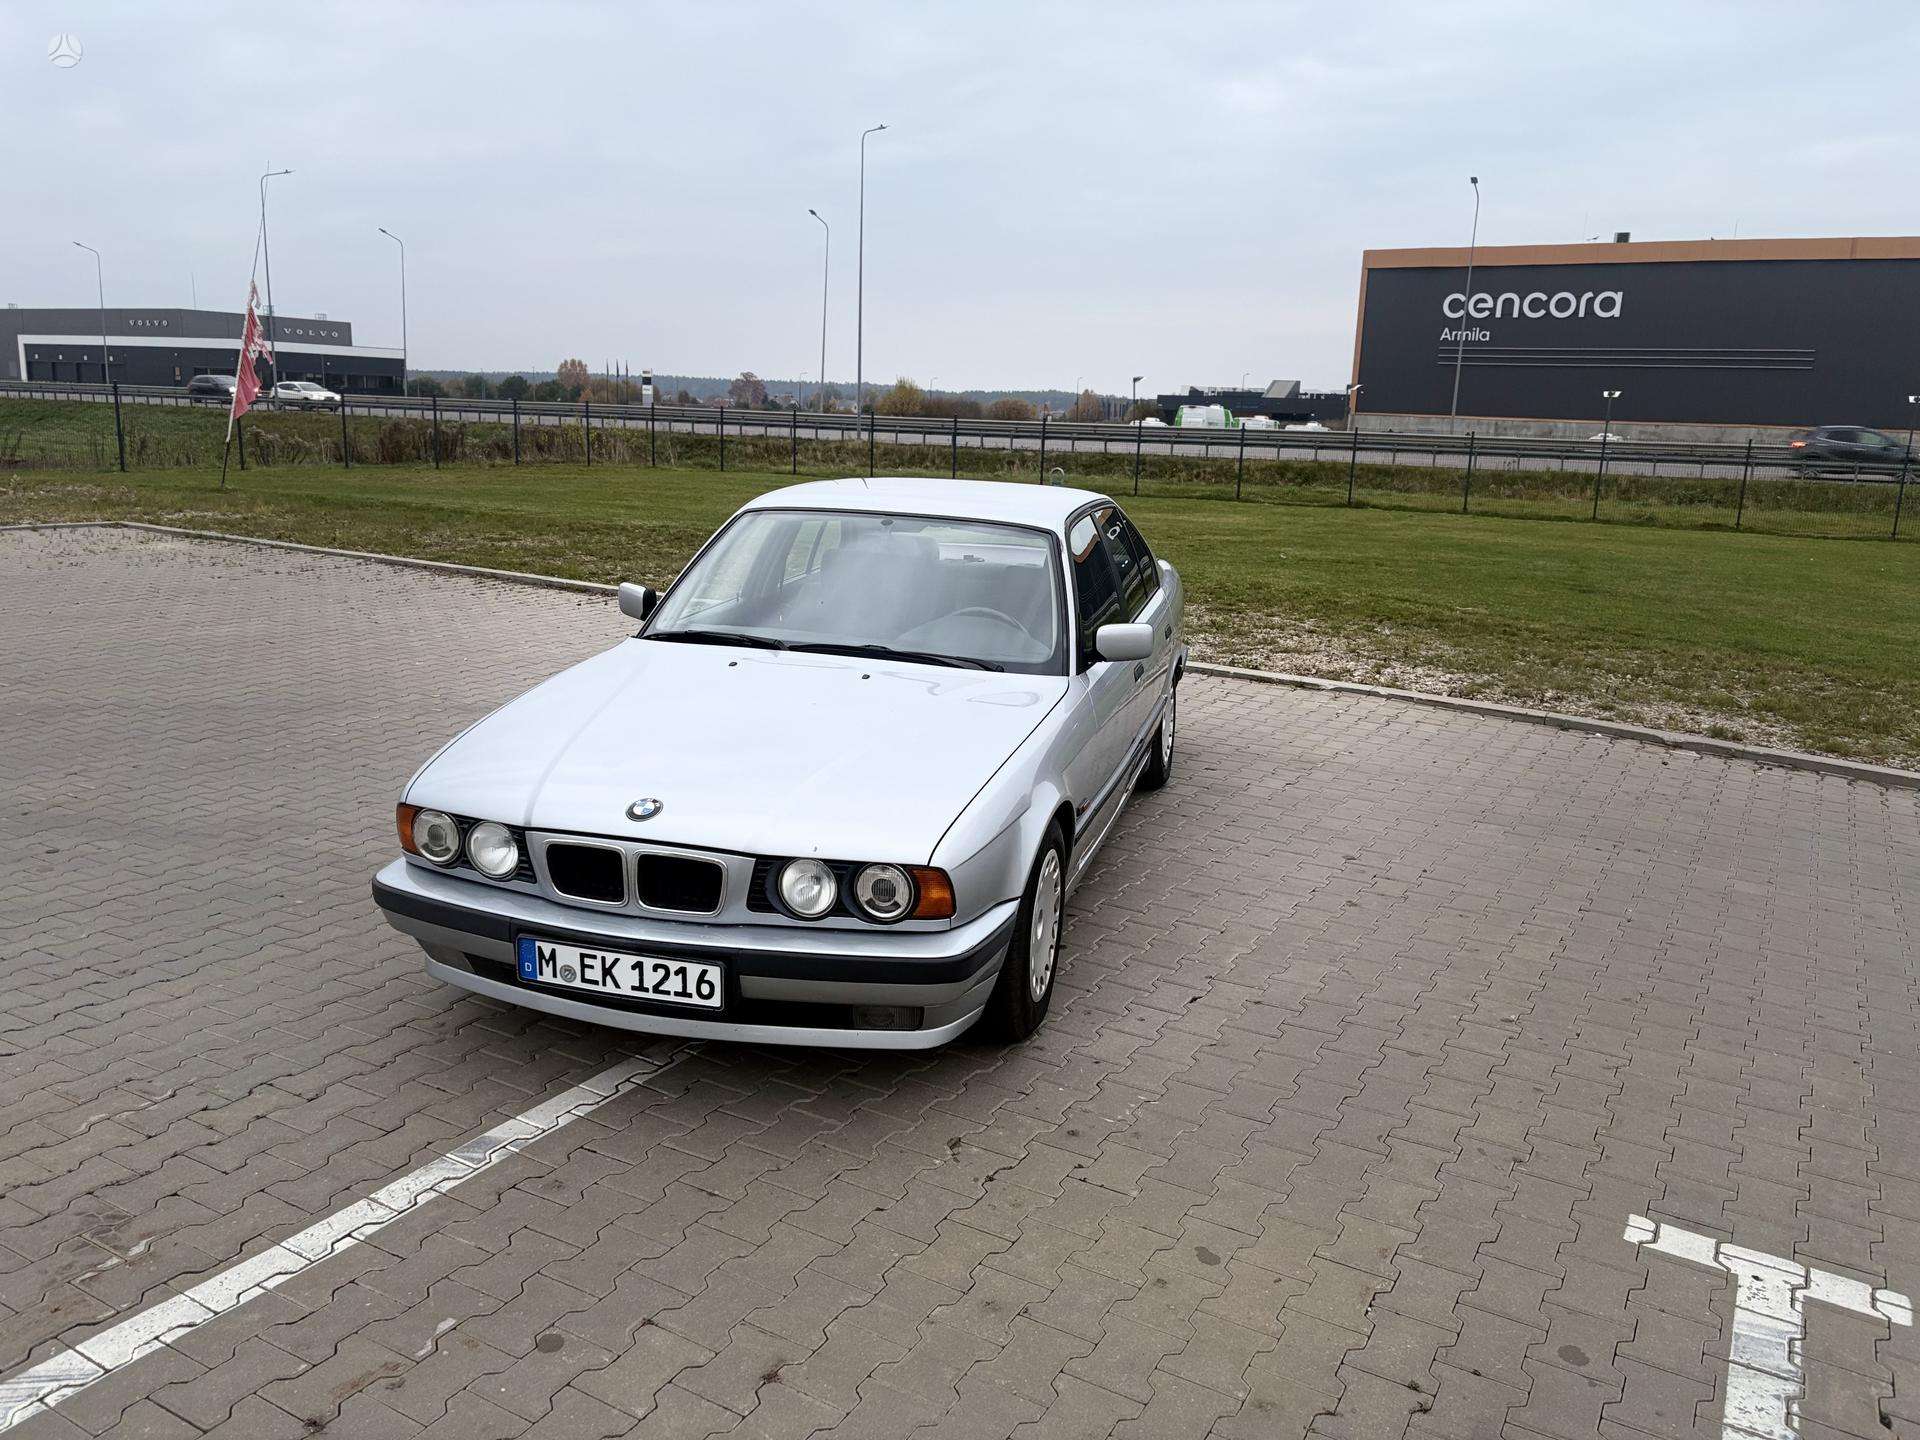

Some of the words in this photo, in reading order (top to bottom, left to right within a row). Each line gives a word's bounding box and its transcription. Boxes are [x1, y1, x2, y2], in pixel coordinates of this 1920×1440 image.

[1443, 291, 1623, 318] cencora
[129, 319, 169, 327] VOLVO
[283, 327, 339, 337] VOLVO
[1440, 327, 1490, 342] Armila
[525, 963, 532, 972] D
[537, 946, 557, 978] M
[580, 953, 621, 990] EK
[631, 961, 715, 1001] 1216
